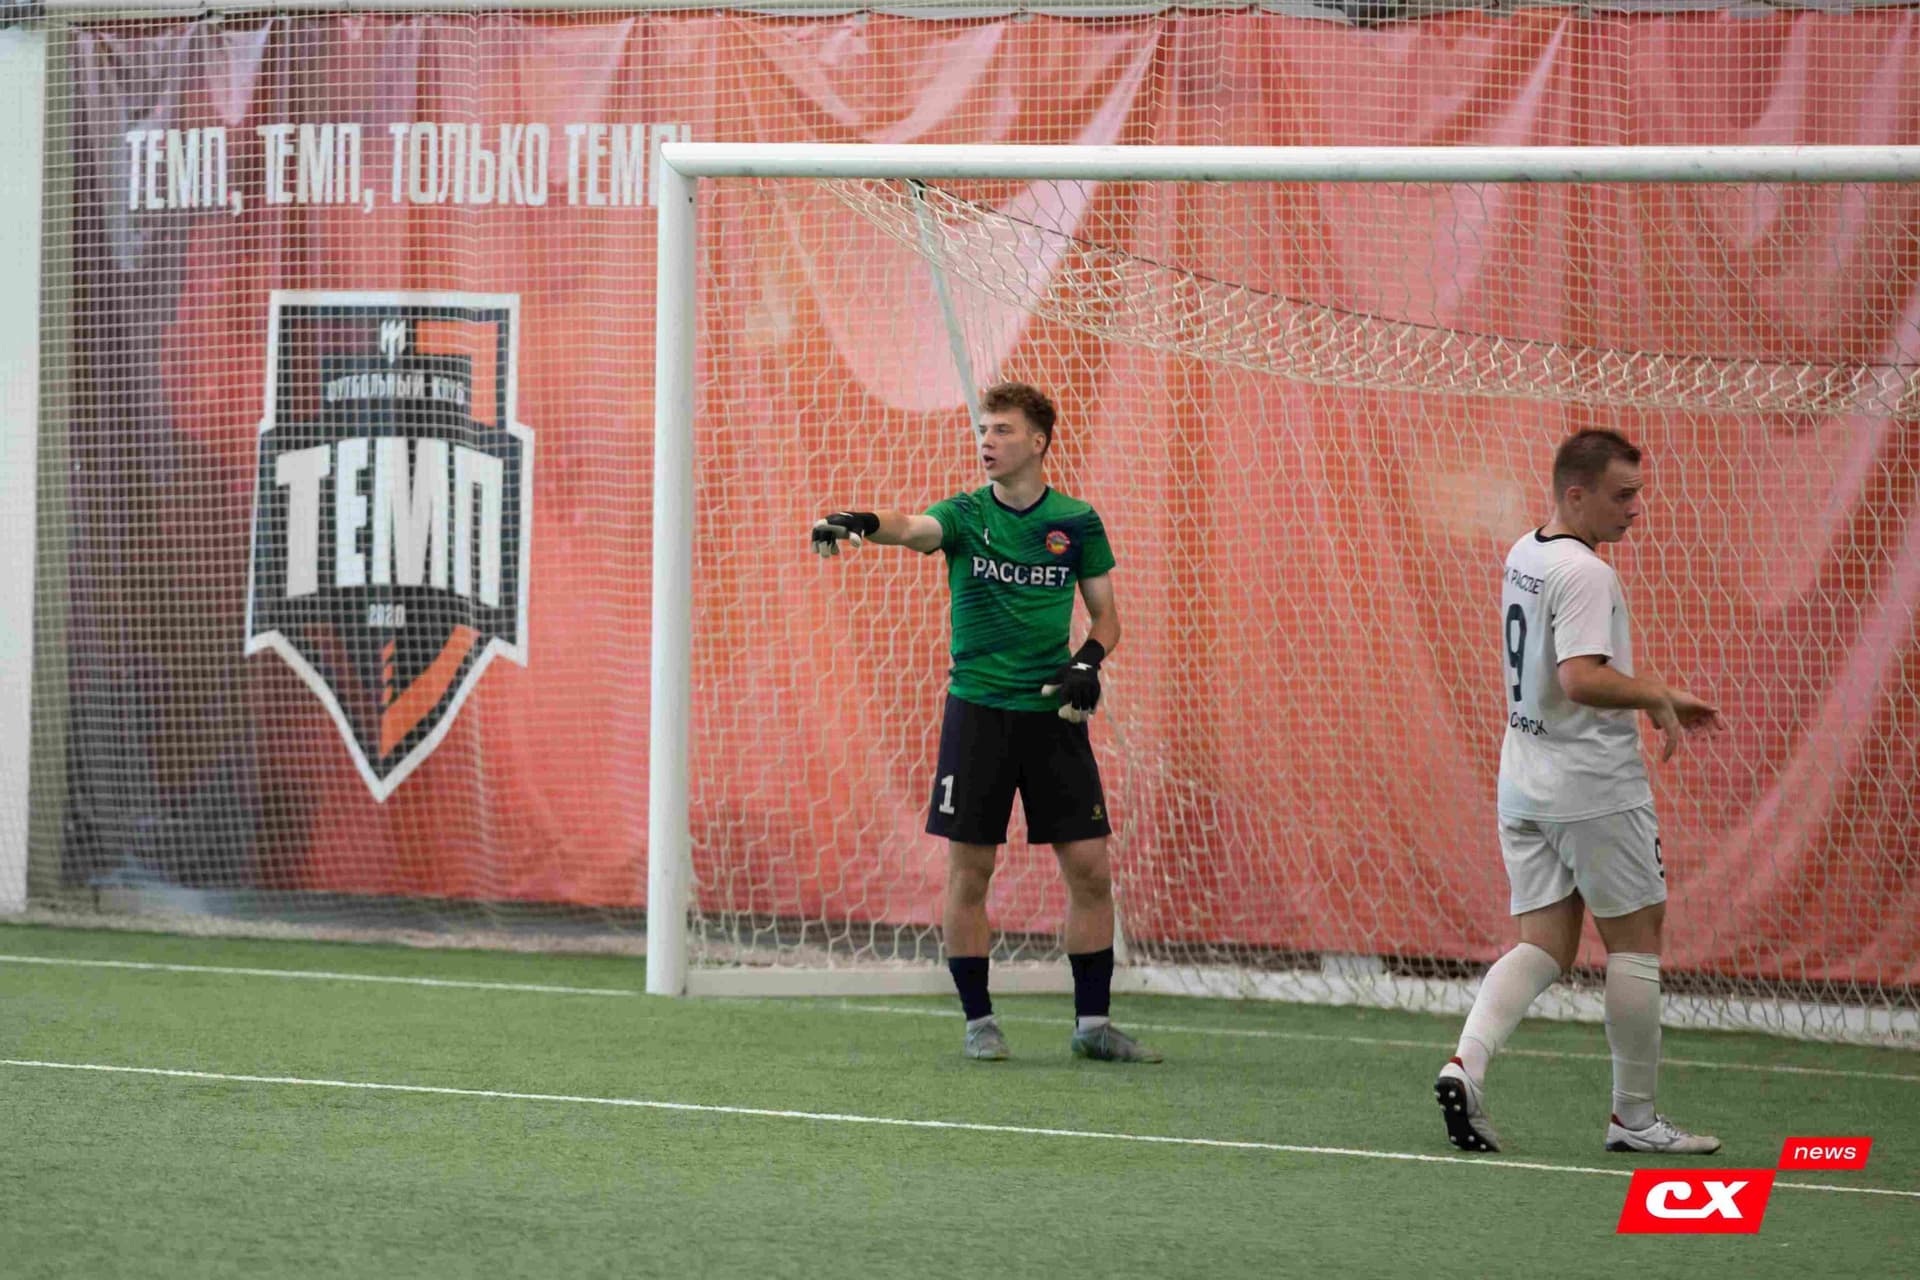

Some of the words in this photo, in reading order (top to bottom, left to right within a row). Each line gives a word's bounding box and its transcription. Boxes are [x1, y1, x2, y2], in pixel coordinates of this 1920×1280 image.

[126, 126, 243, 216] ТЕМП,
[256, 122, 374, 214] ТЕМП,
[389, 122, 548, 206] ТОЛЬКО
[565, 122, 691, 207] ТЕМП
[275, 436, 503, 609] ТЕМП
[972, 555, 1070, 587] РАССВЕТ
[1506, 603, 1527, 702] 9
[939, 774, 955, 815] 1
